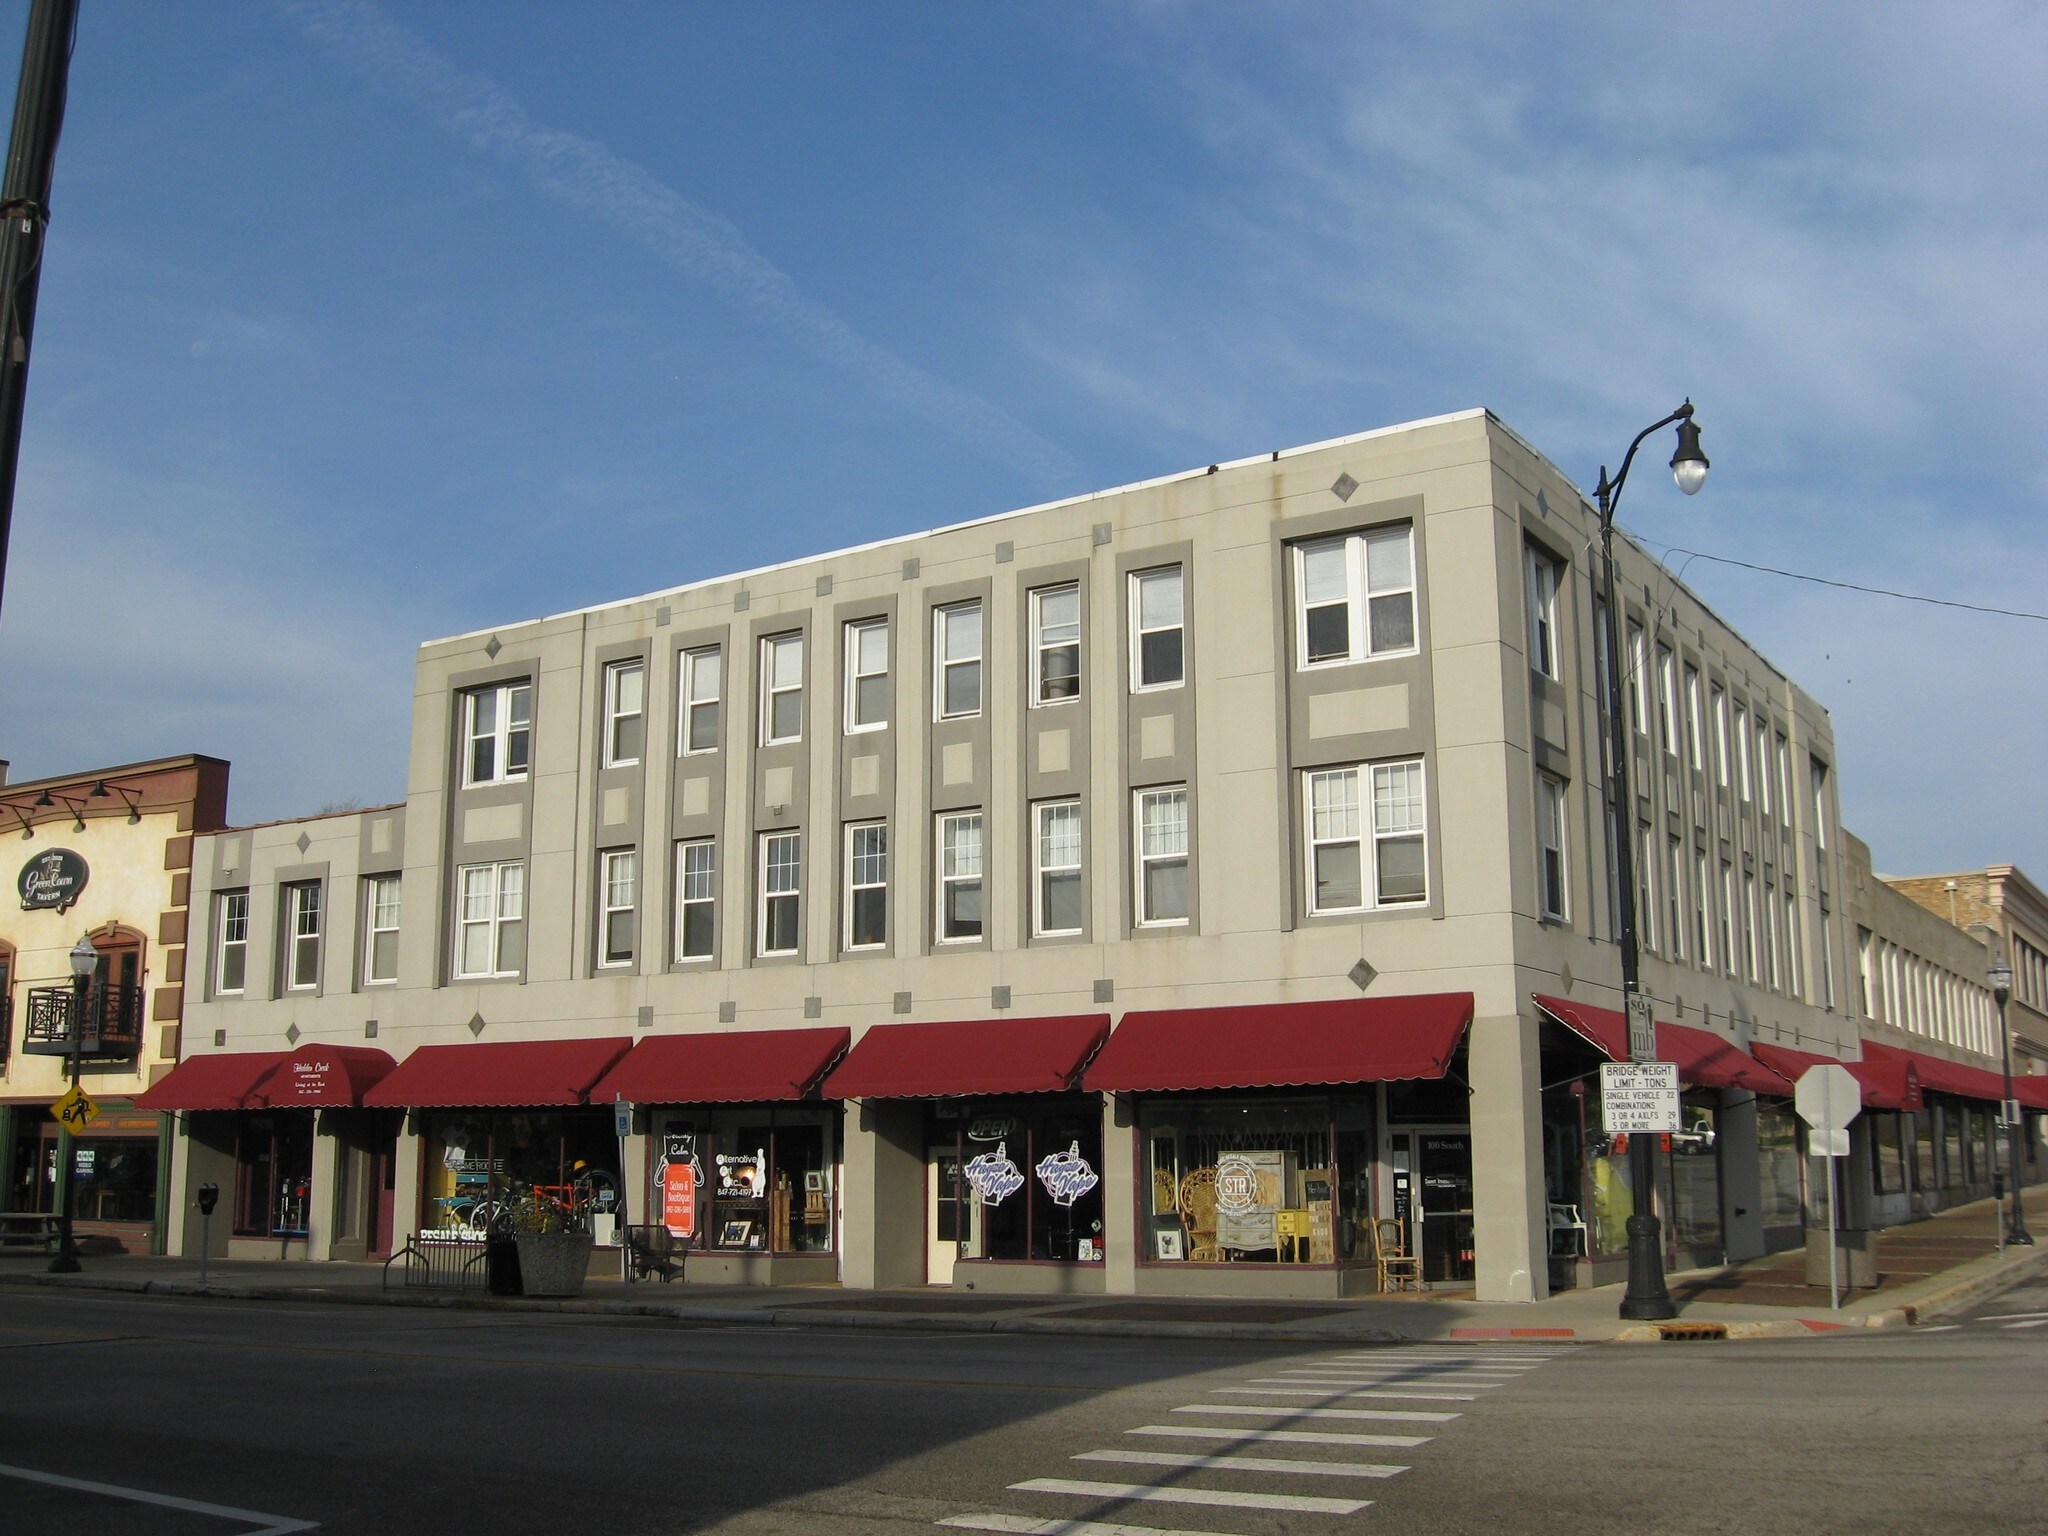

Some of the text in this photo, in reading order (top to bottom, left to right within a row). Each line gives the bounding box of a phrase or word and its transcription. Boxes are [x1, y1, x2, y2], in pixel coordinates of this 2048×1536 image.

[37, 892, 60, 900] TAVERN
[1607, 1066, 1671, 1076] BRIDGE WEIGHT
[1614, 1079, 1635, 1088] LIMIT
[1644, 1078, 1666, 1087] TONS
[971, 1120, 1011, 1136] OPEN
[1428, 1141, 1463, 1149] 100 South
[716, 1154, 758, 1165] Alternative
[720, 1165, 732, 1176] Art
[986, 1173, 1024, 1201] Vape
[1059, 1173, 1098, 1200] Vape
[1225, 1178, 1246, 1193] STR
